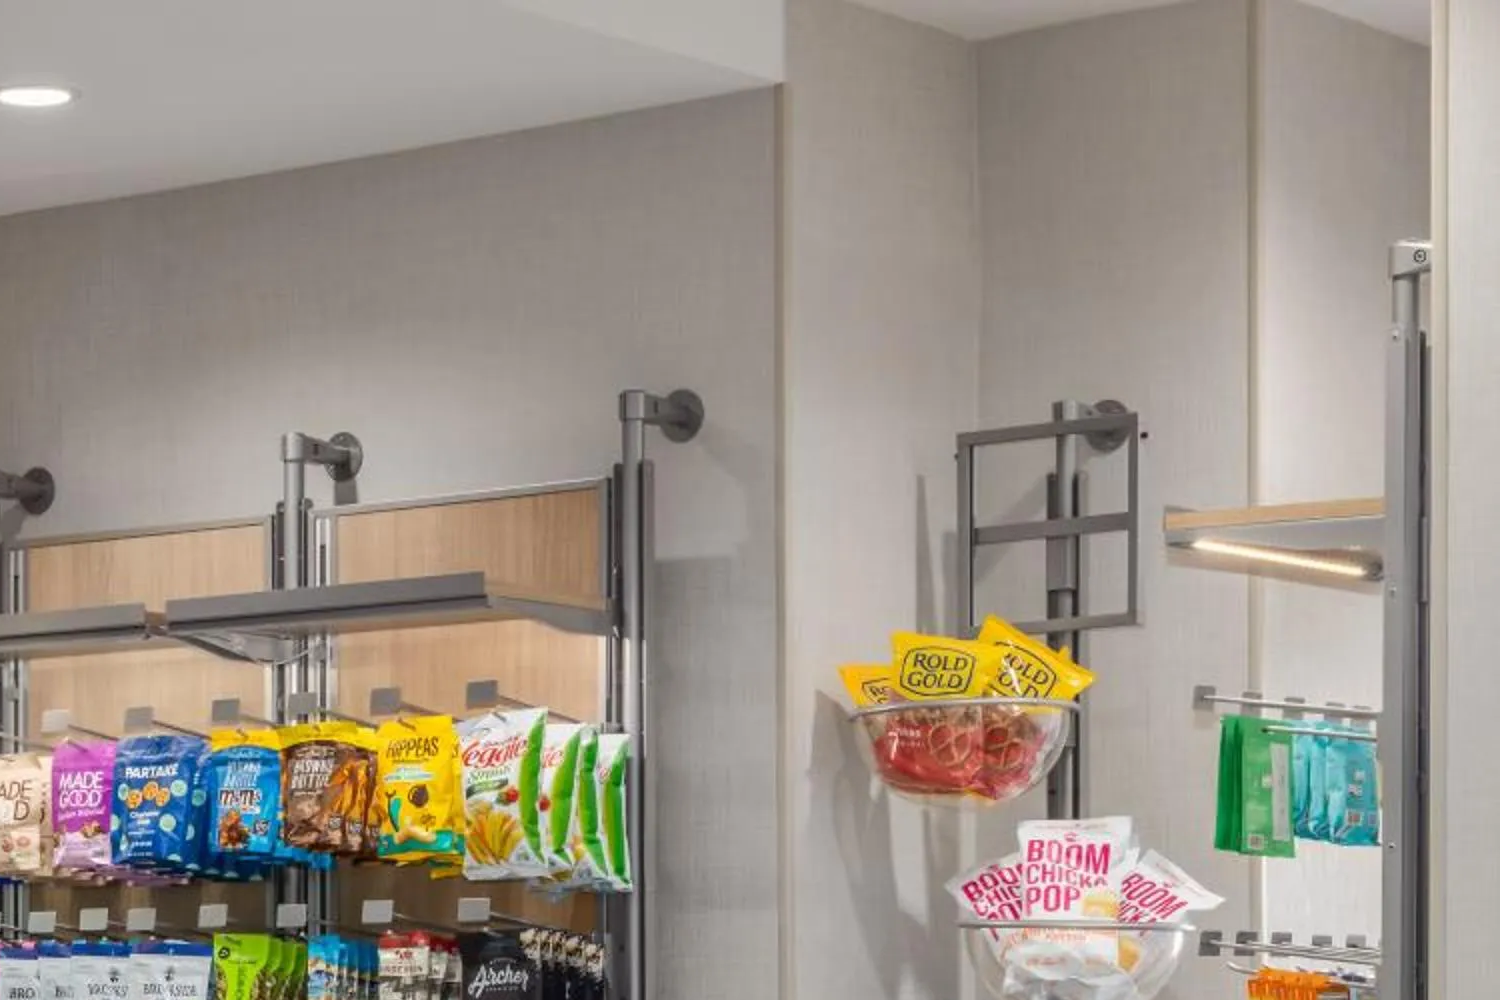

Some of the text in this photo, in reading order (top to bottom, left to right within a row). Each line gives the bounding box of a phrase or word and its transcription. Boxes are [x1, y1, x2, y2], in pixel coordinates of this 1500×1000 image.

[913, 652, 969, 671] ROLD
[907, 671, 963, 689] GOLD
[59, 772, 105, 789] MADE
[125, 763, 179, 779] PARTAKE
[59, 790, 102, 808] GOOD
[1027, 839, 1111, 875] BOOM
[1026, 864, 1109, 888] CHICKA
[973, 886, 1022, 918] CHIC
[1025, 885, 1081, 917] POP
[1122, 872, 1188, 920] BOOM
[467, 963, 529, 999] Archer
